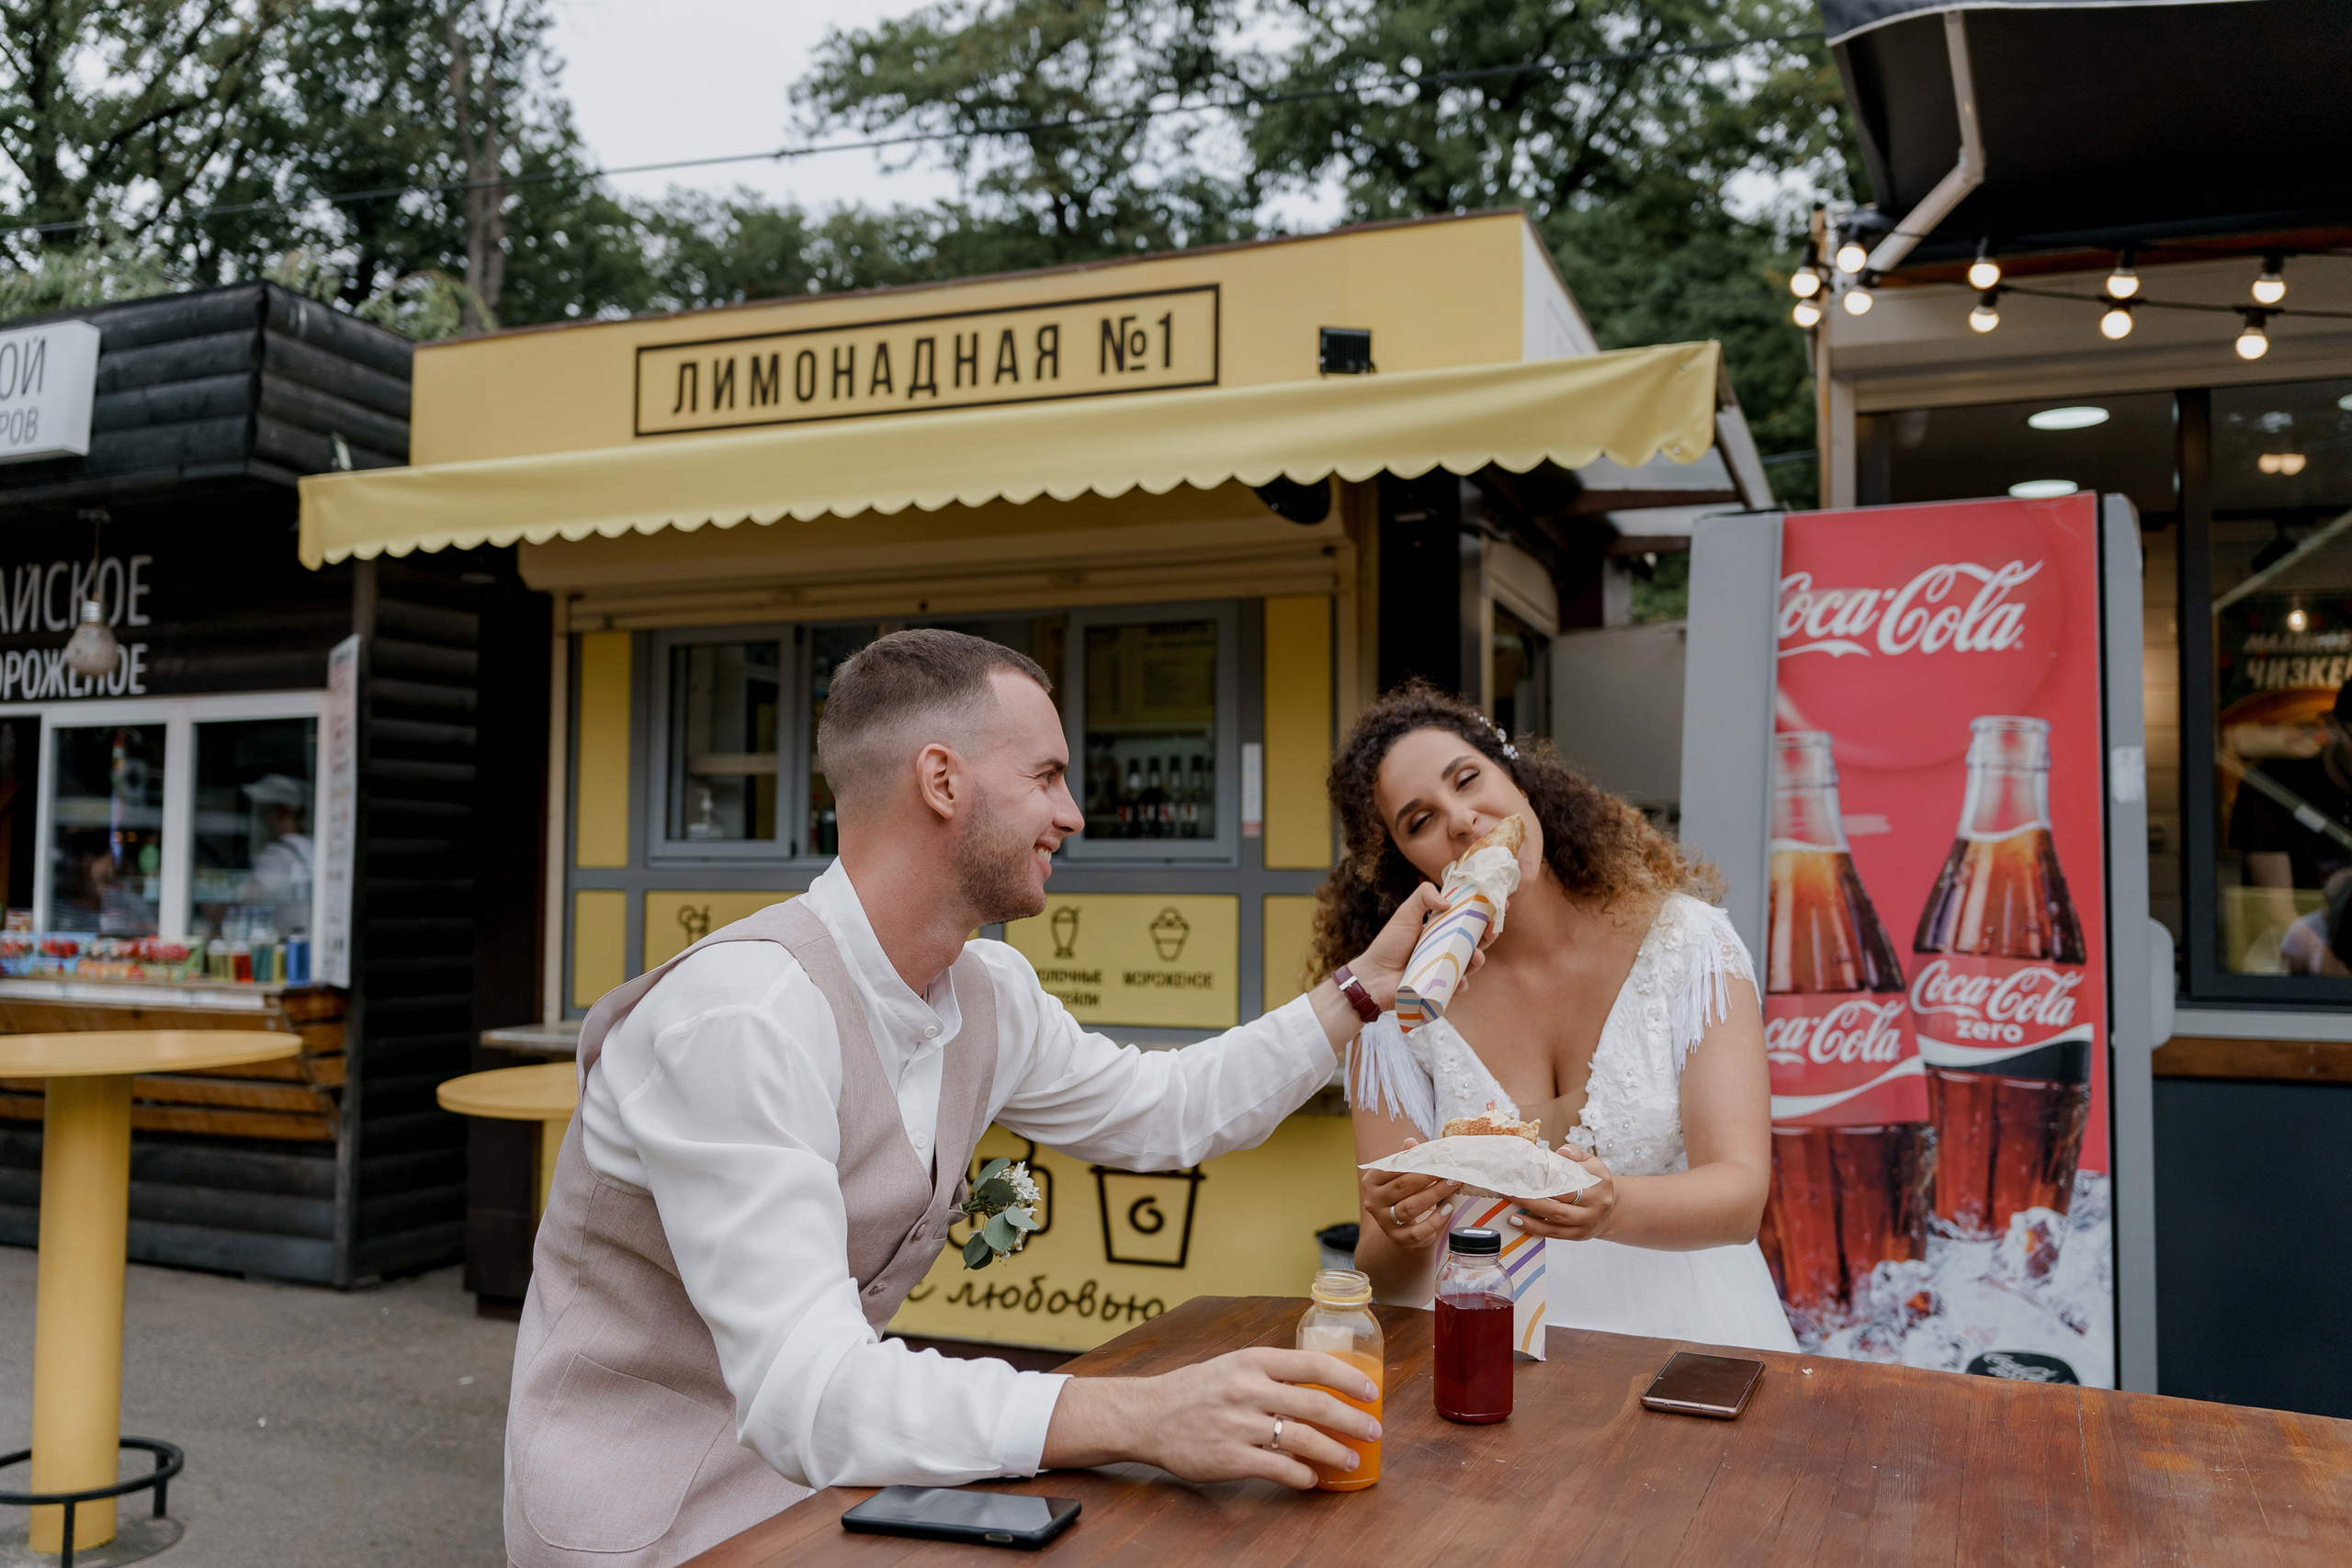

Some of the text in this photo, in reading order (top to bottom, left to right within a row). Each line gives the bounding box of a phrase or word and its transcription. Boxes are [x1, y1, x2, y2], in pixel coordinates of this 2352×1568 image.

[0, 336, 46, 400] ОЙ
[673, 310, 1174, 415] ЛИМОНАДНАЯ №1
[0, 643, 148, 700] РОЖОЕ
[1037, 968, 1102, 987] ОЛОЧНЫЕ
[1122, 969, 1214, 989] МОРОЖЕНОЕ
[1910, 958, 2086, 1029] Coca-Cola
[1764, 998, 1905, 1066] ca-Cola
[1955, 1017, 2024, 1044] zero
[946, 1273, 1165, 1323] любовью
